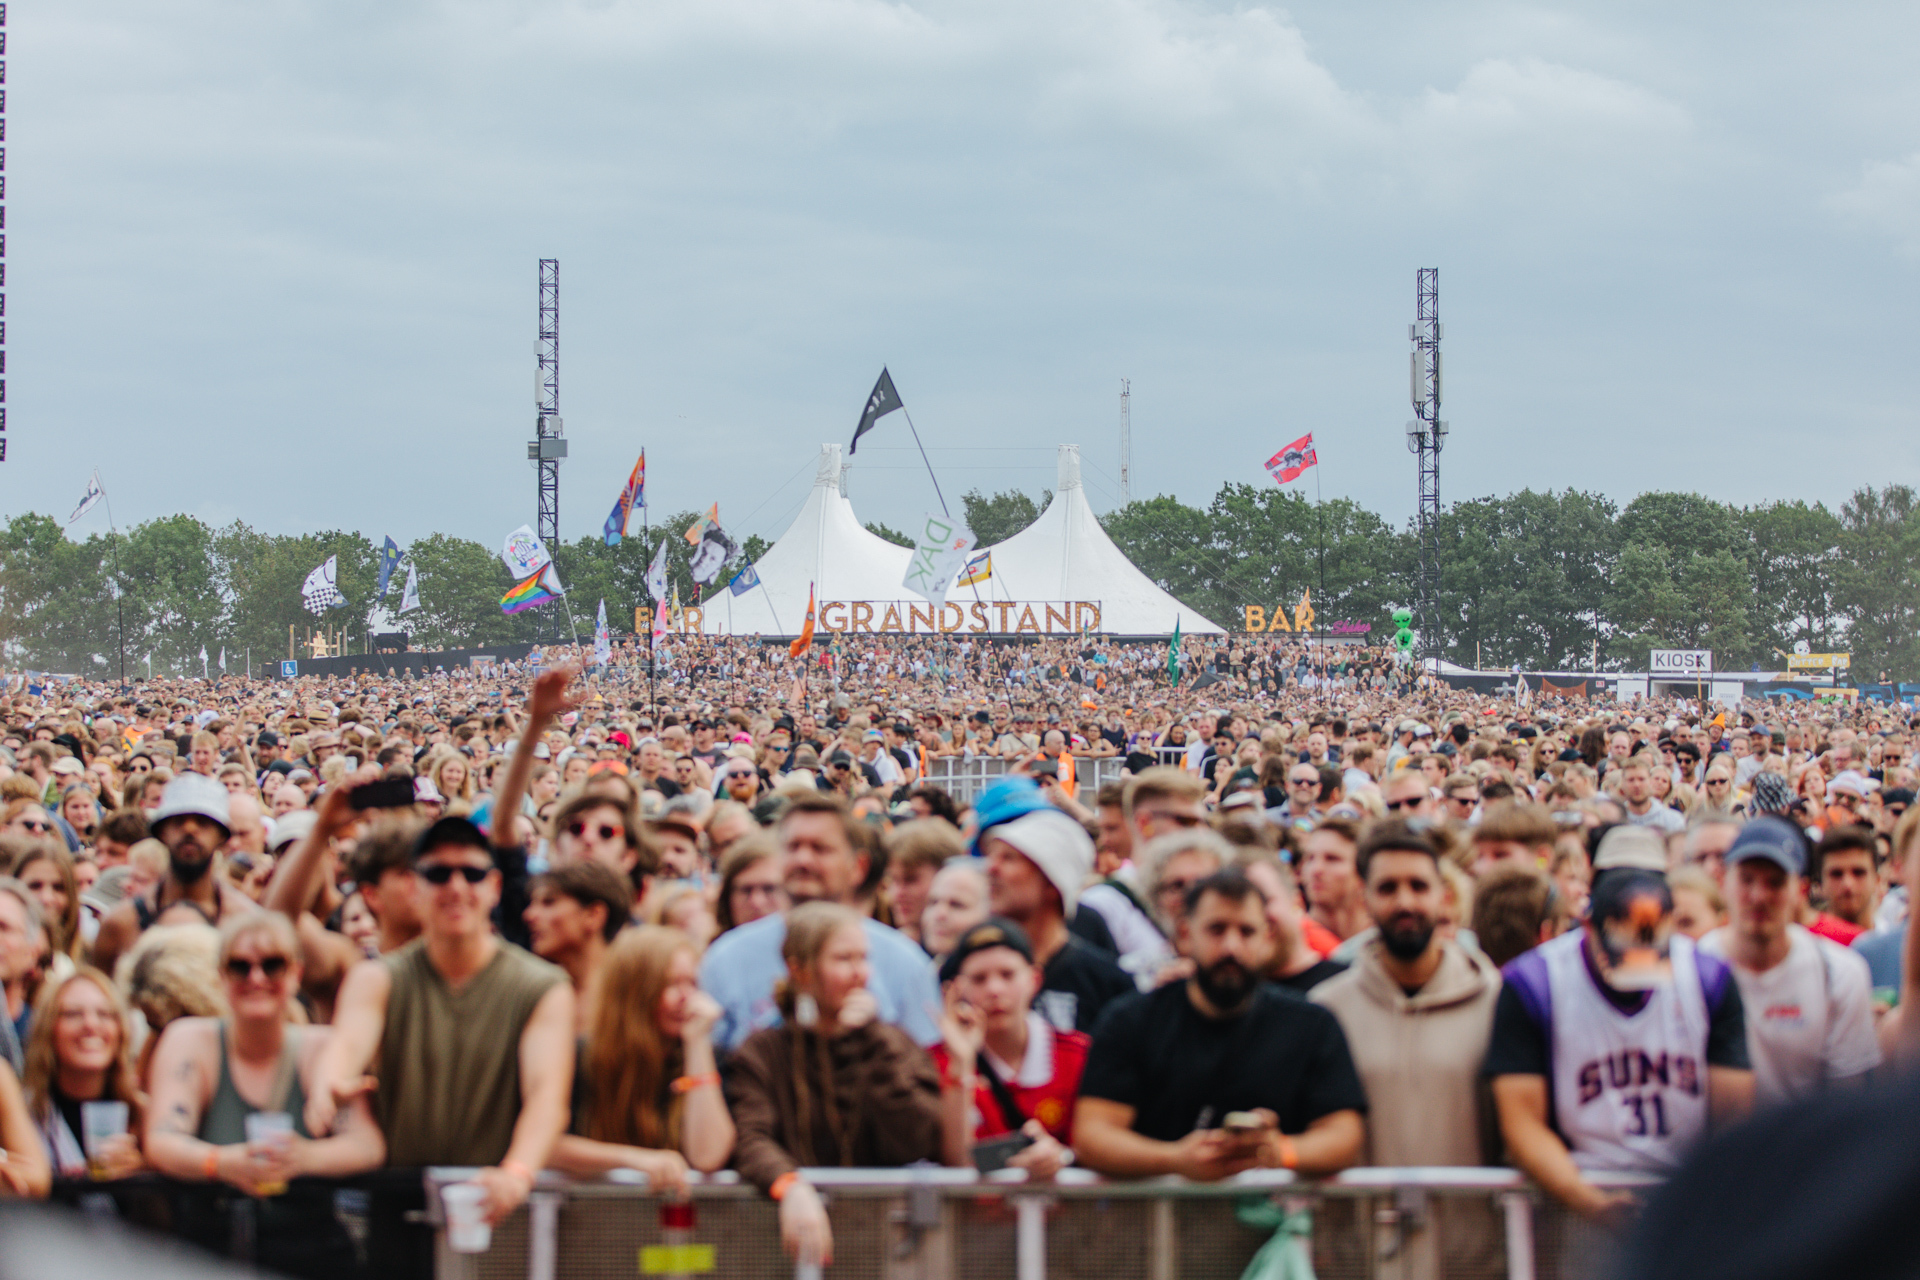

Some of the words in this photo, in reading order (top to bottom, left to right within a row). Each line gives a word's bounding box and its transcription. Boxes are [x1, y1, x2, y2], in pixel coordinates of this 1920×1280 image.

[820, 601, 1101, 633] GRANDSTAND
[1245, 605, 1316, 633] BAR
[1655, 653, 1706, 667] KIOSK
[1577, 1047, 1701, 1105] SUNS
[1621, 1093, 1670, 1137] 31
